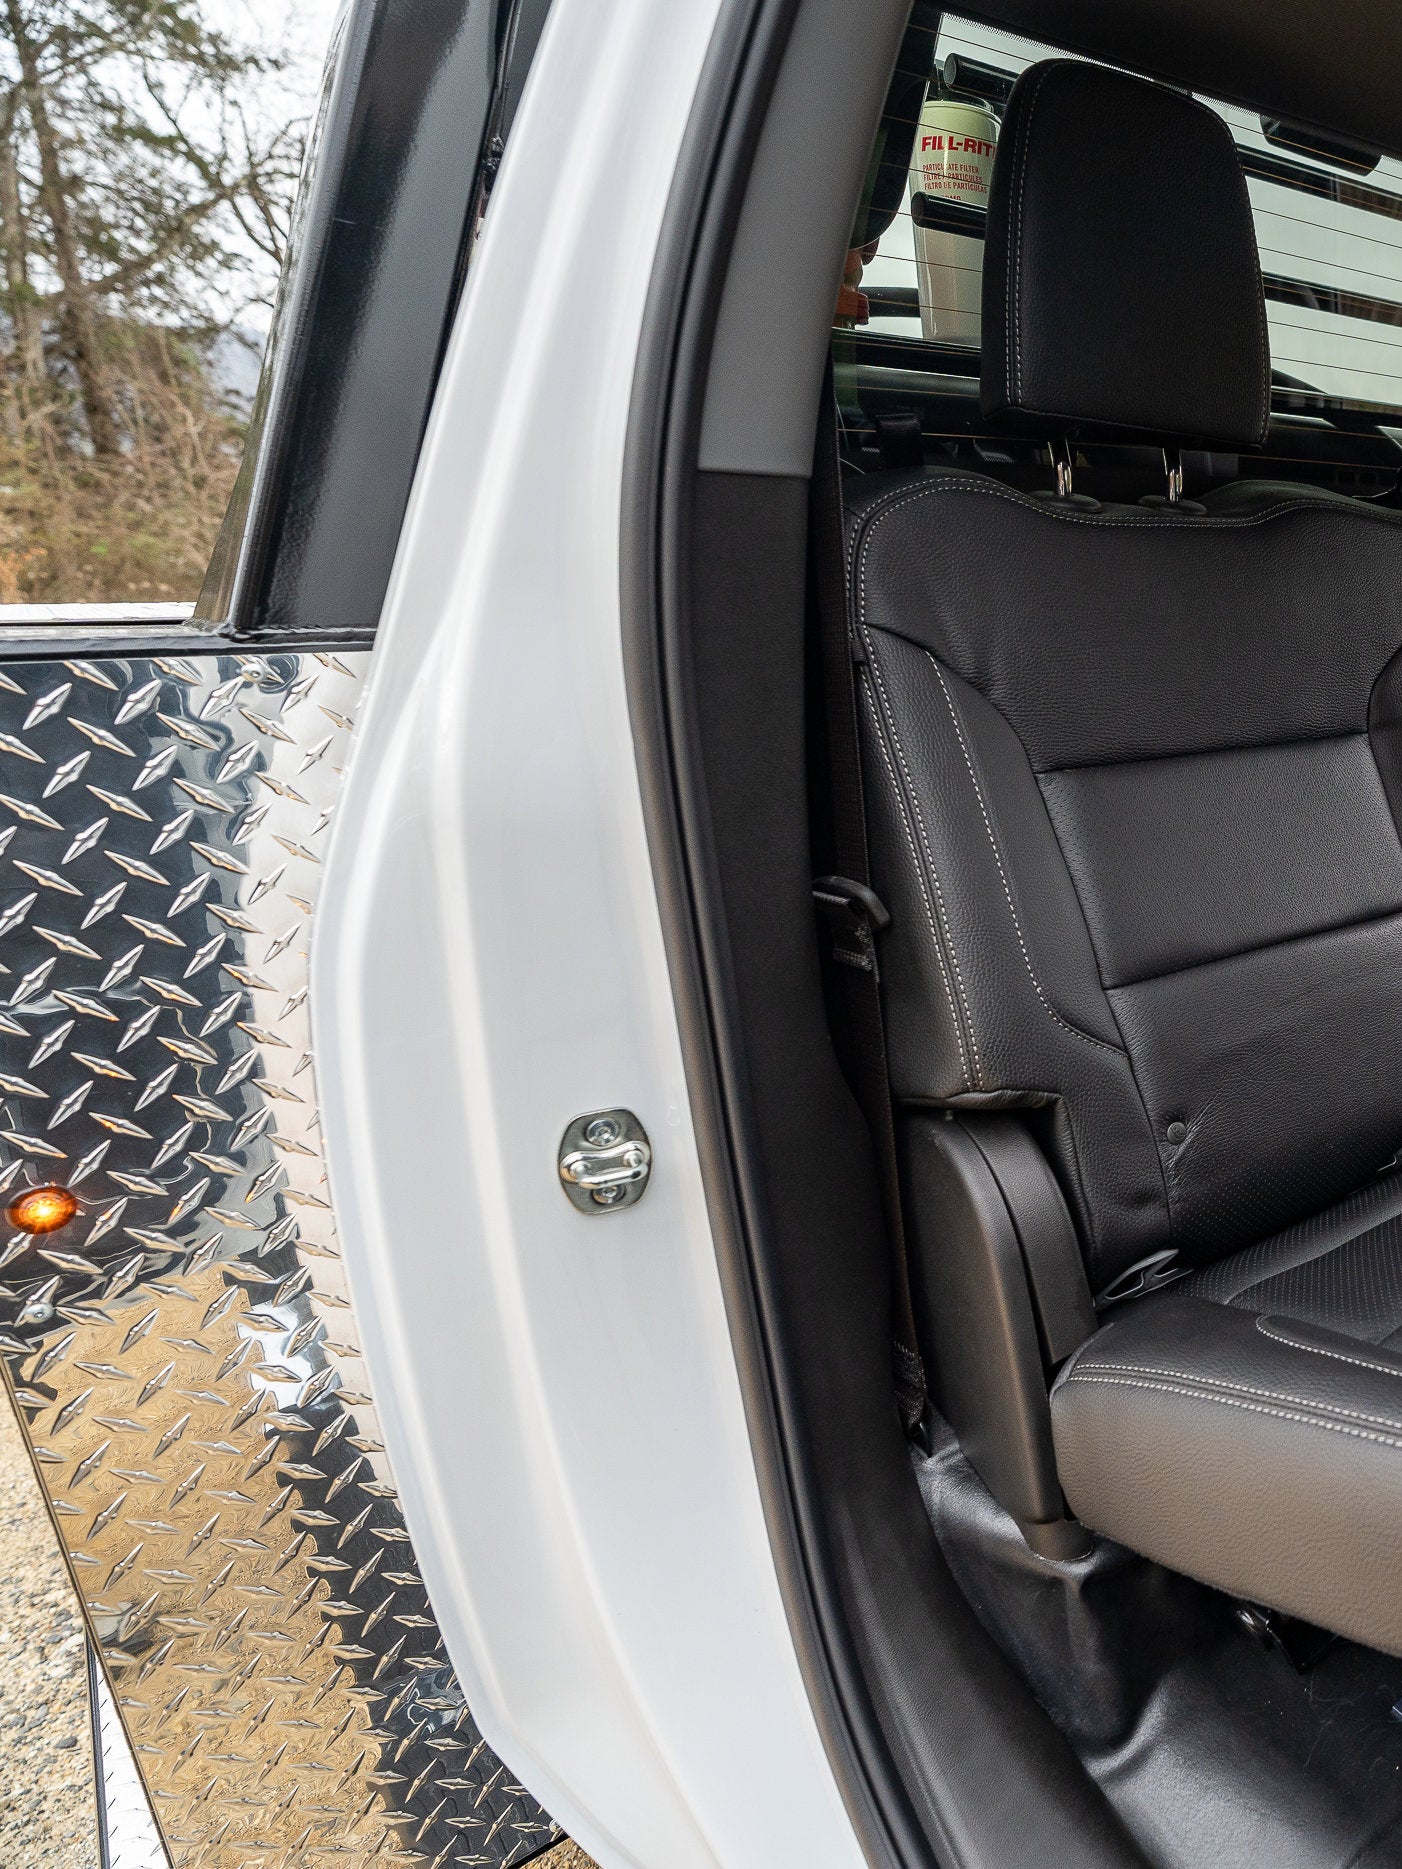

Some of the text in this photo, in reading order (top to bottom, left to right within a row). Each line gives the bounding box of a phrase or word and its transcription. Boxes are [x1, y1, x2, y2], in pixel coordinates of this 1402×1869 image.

[923, 163, 979, 173] PARTICUATE FILTER
[948, 173, 983, 183] PARTICULES
[924, 182, 942, 190] FILTRO
